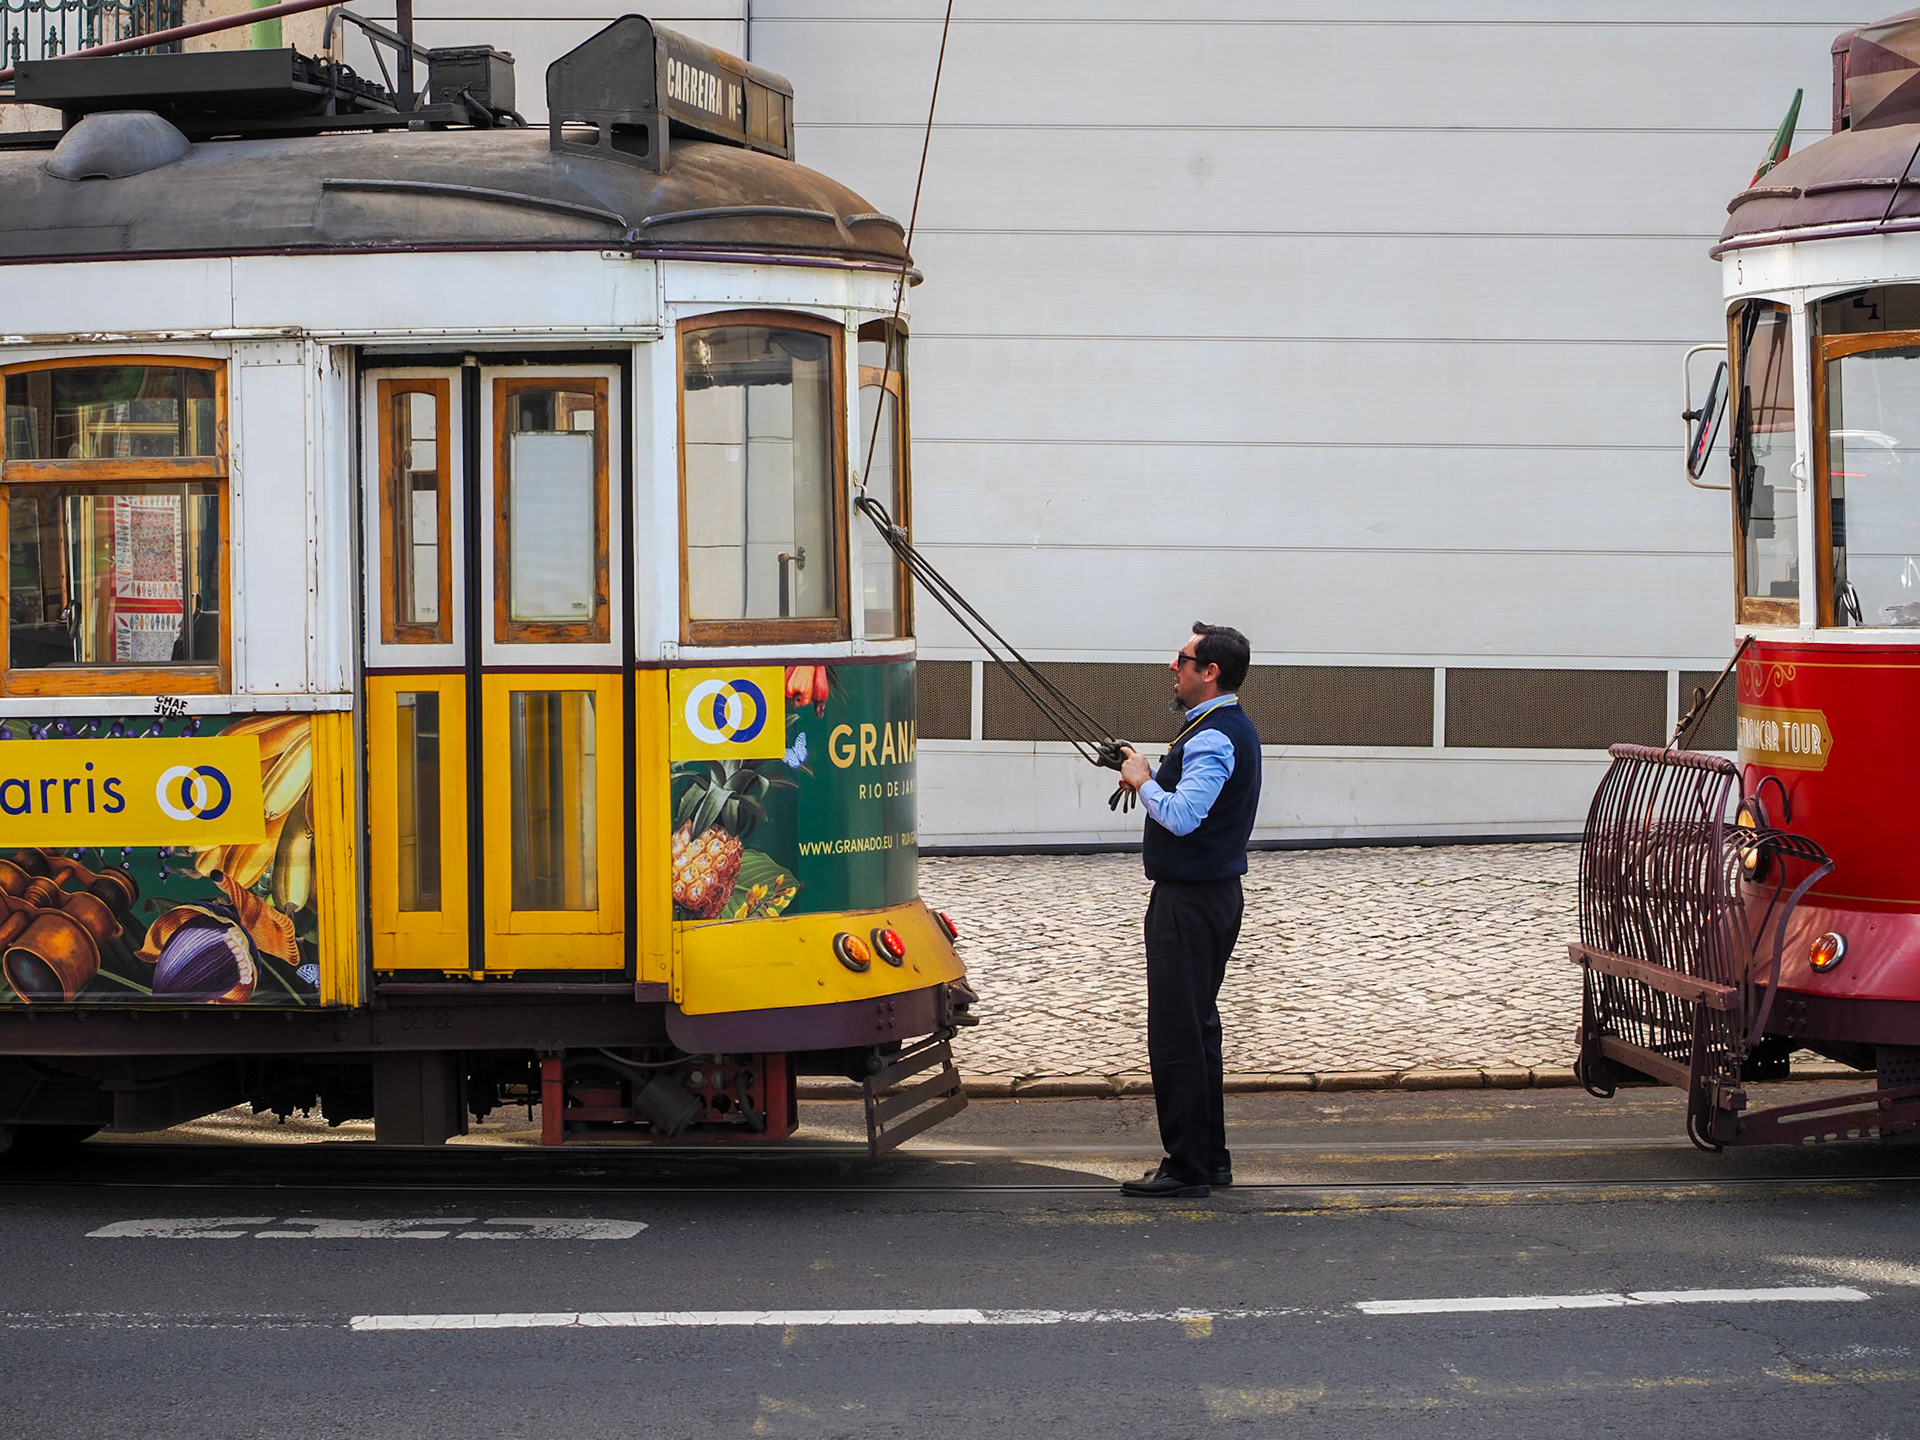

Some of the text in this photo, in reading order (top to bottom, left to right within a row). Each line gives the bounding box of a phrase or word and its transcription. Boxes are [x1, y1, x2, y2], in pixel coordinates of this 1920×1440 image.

[667, 57, 723, 116] CARREIRA
[1737, 259, 1743, 286] 5
[1782, 721, 1822, 755] TOUR
[0, 761, 126, 815] arris
[859, 782, 882, 800] RIO
[887, 781, 899, 797] DE
[798, 834, 893, 856] WWW.GRANADO.EU
